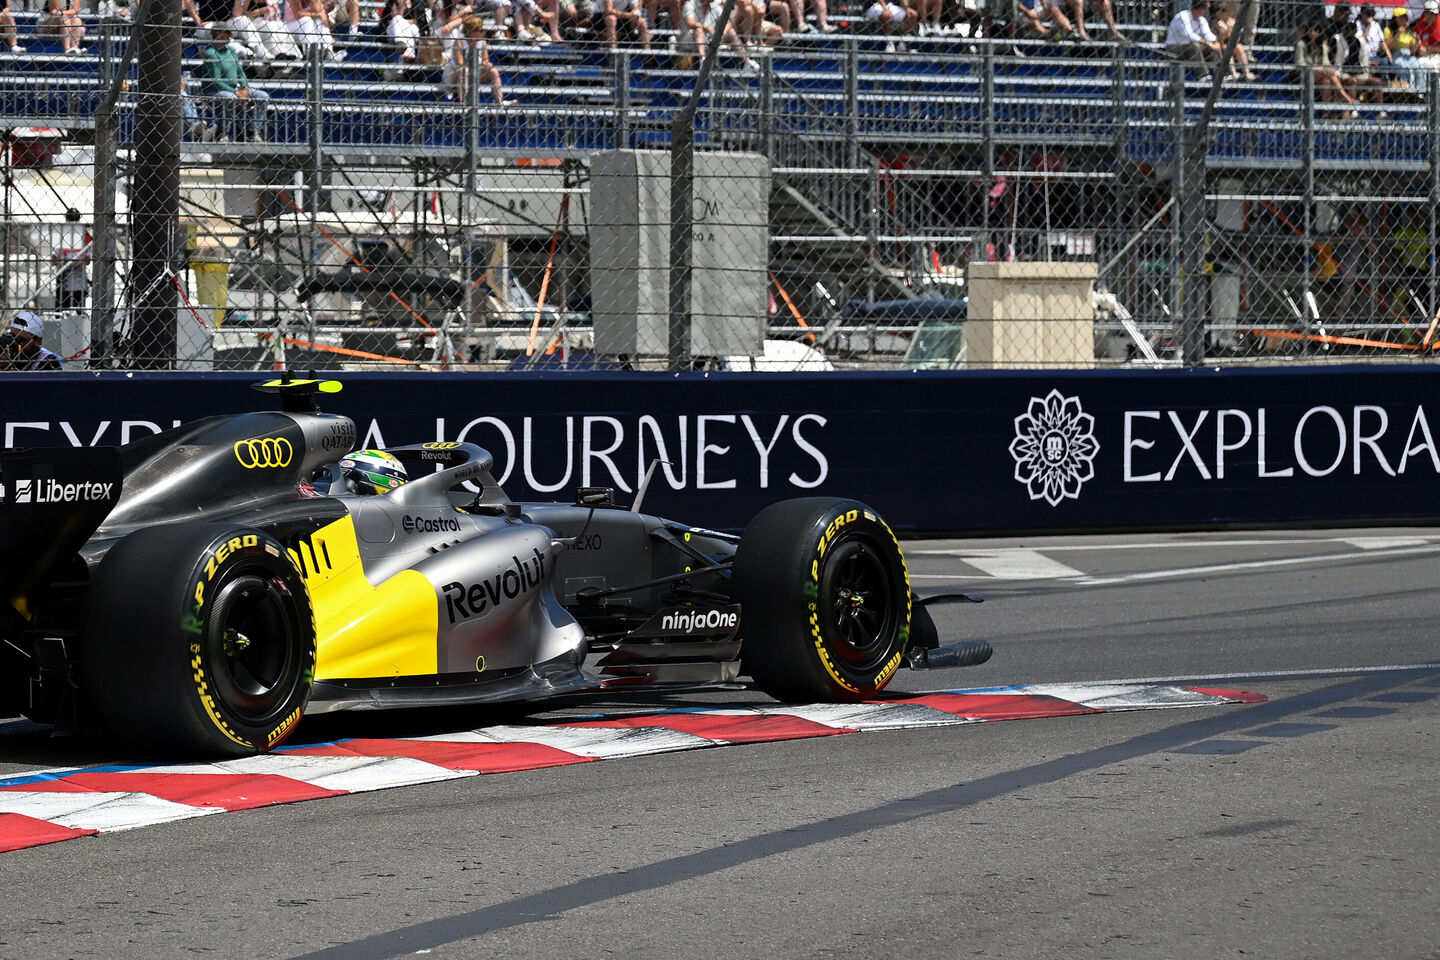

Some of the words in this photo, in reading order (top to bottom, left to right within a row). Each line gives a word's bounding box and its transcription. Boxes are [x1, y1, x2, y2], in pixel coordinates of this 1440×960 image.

[330, 422, 354, 435] visit
[322, 436, 354, 451] QATAR
[1124, 404, 1440, 482] EXPLORA
[421, 451, 452, 460] Revolut
[36, 478, 113, 502] Libertex
[416, 516, 461, 533] Castrol
[817, 509, 858, 558] ZERO
[204, 534, 258, 581] ZERO
[441, 547, 545, 624] Revolut
[662, 610, 737, 634] ninjaOne
